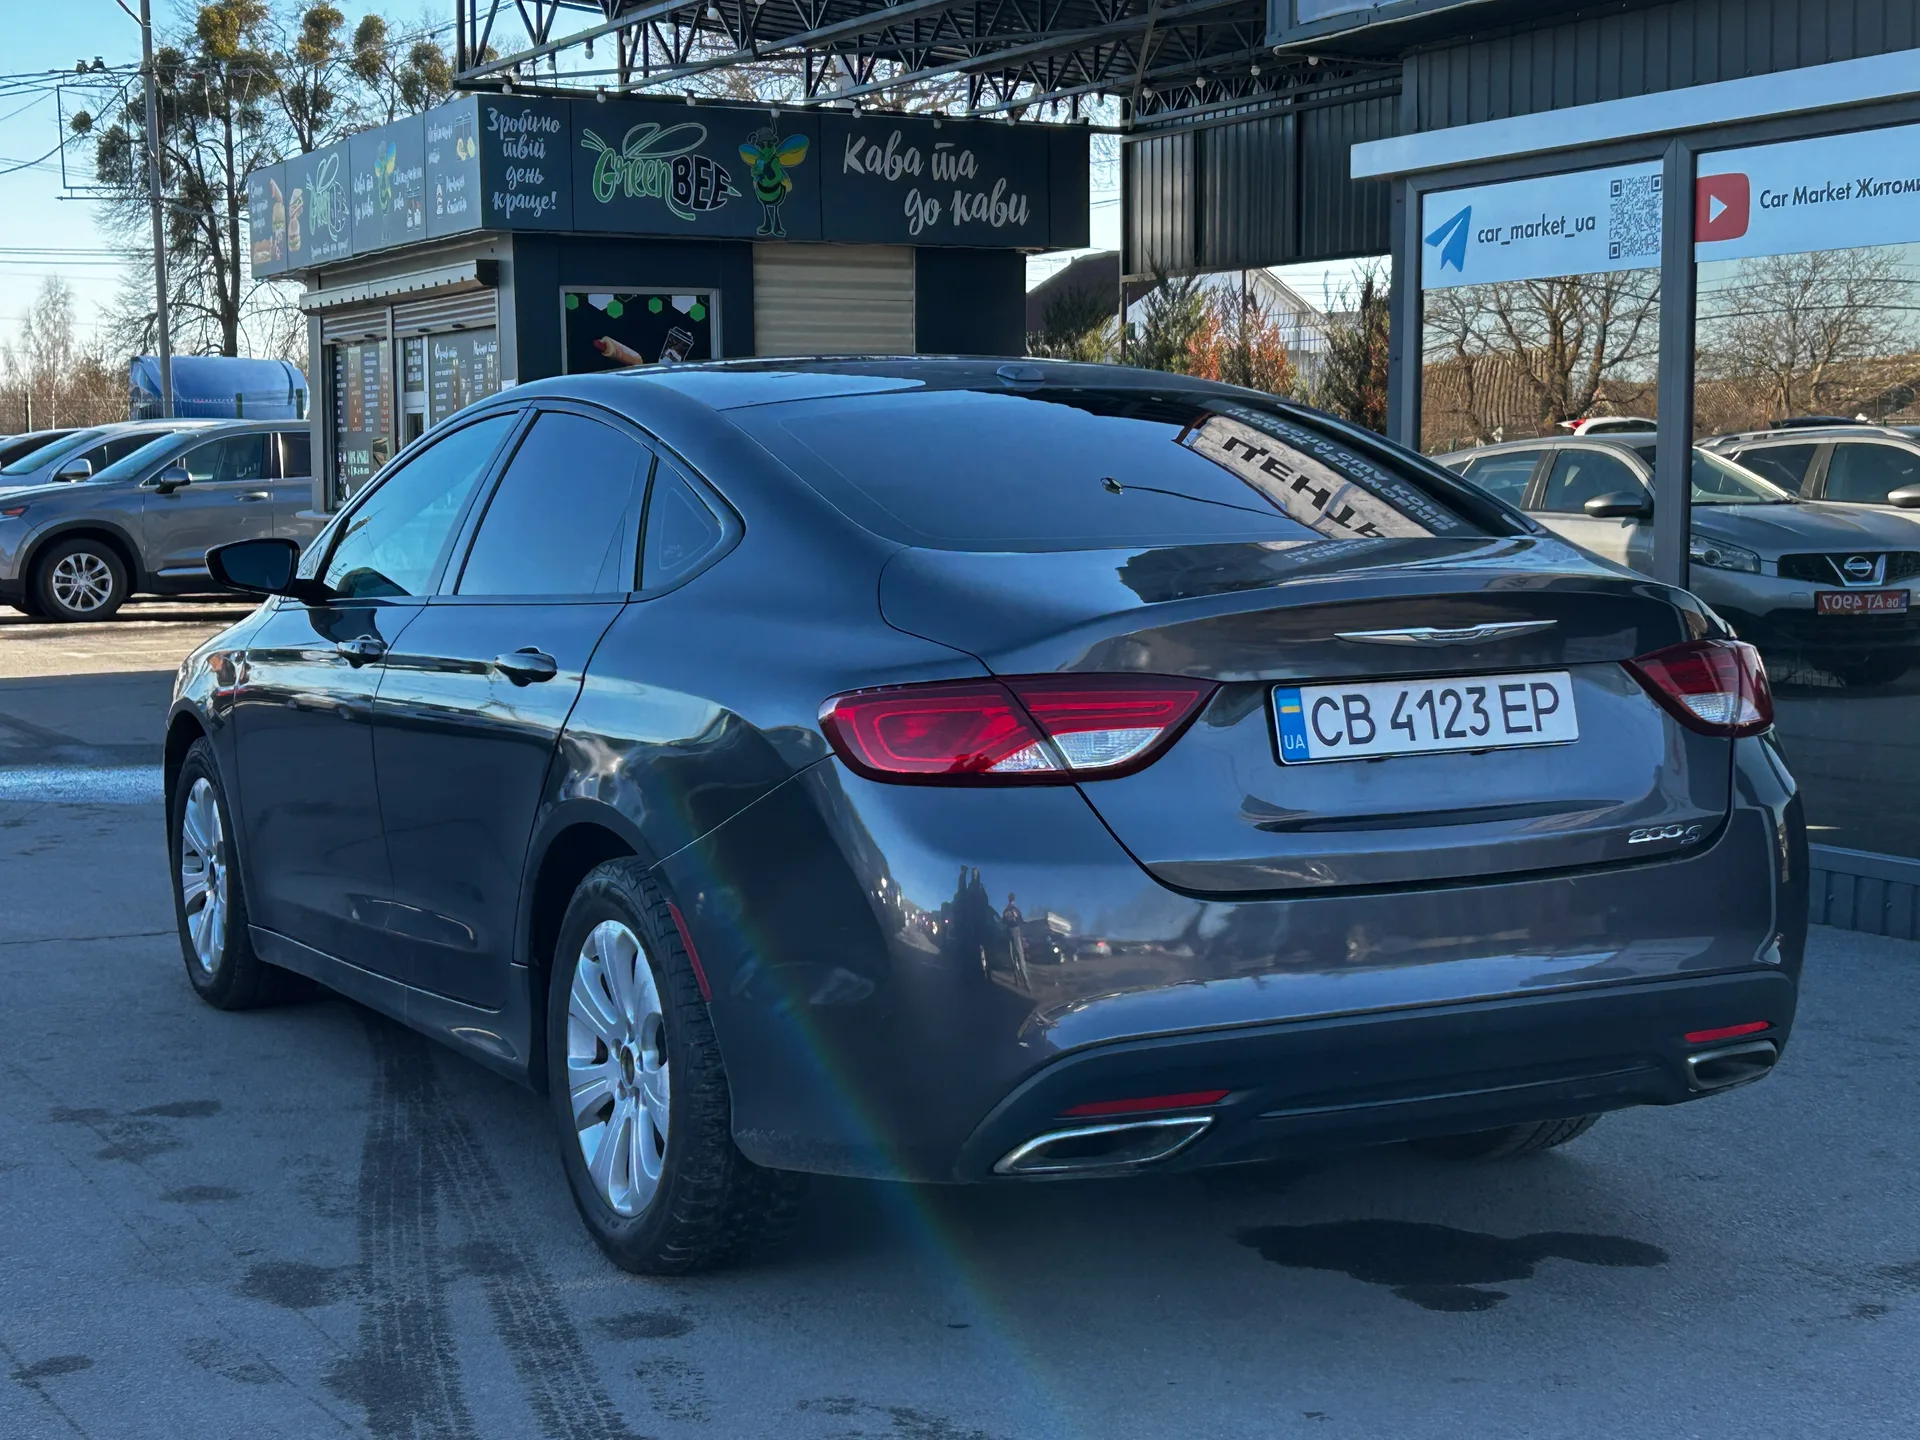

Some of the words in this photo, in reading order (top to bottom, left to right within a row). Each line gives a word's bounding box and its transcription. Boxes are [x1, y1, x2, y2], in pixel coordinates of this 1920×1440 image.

[487, 107, 561, 140] Зробимо
[503, 133, 546, 159] твій
[843, 130, 924, 181] Кава
[931, 142, 979, 182] та
[506, 166, 545, 190] день
[492, 191, 557, 219] краще!
[904, 188, 942, 236] до
[949, 178, 1030, 227] кави
[1760, 190, 1788, 209] Car
[1792, 181, 1851, 206] Market
[1477, 213, 1596, 245] car_market_ua
[1311, 694, 1377, 747] CB
[1390, 686, 1491, 742] 4123
[1498, 682, 1560, 734] EP
[1284, 734, 1306, 751] UA
